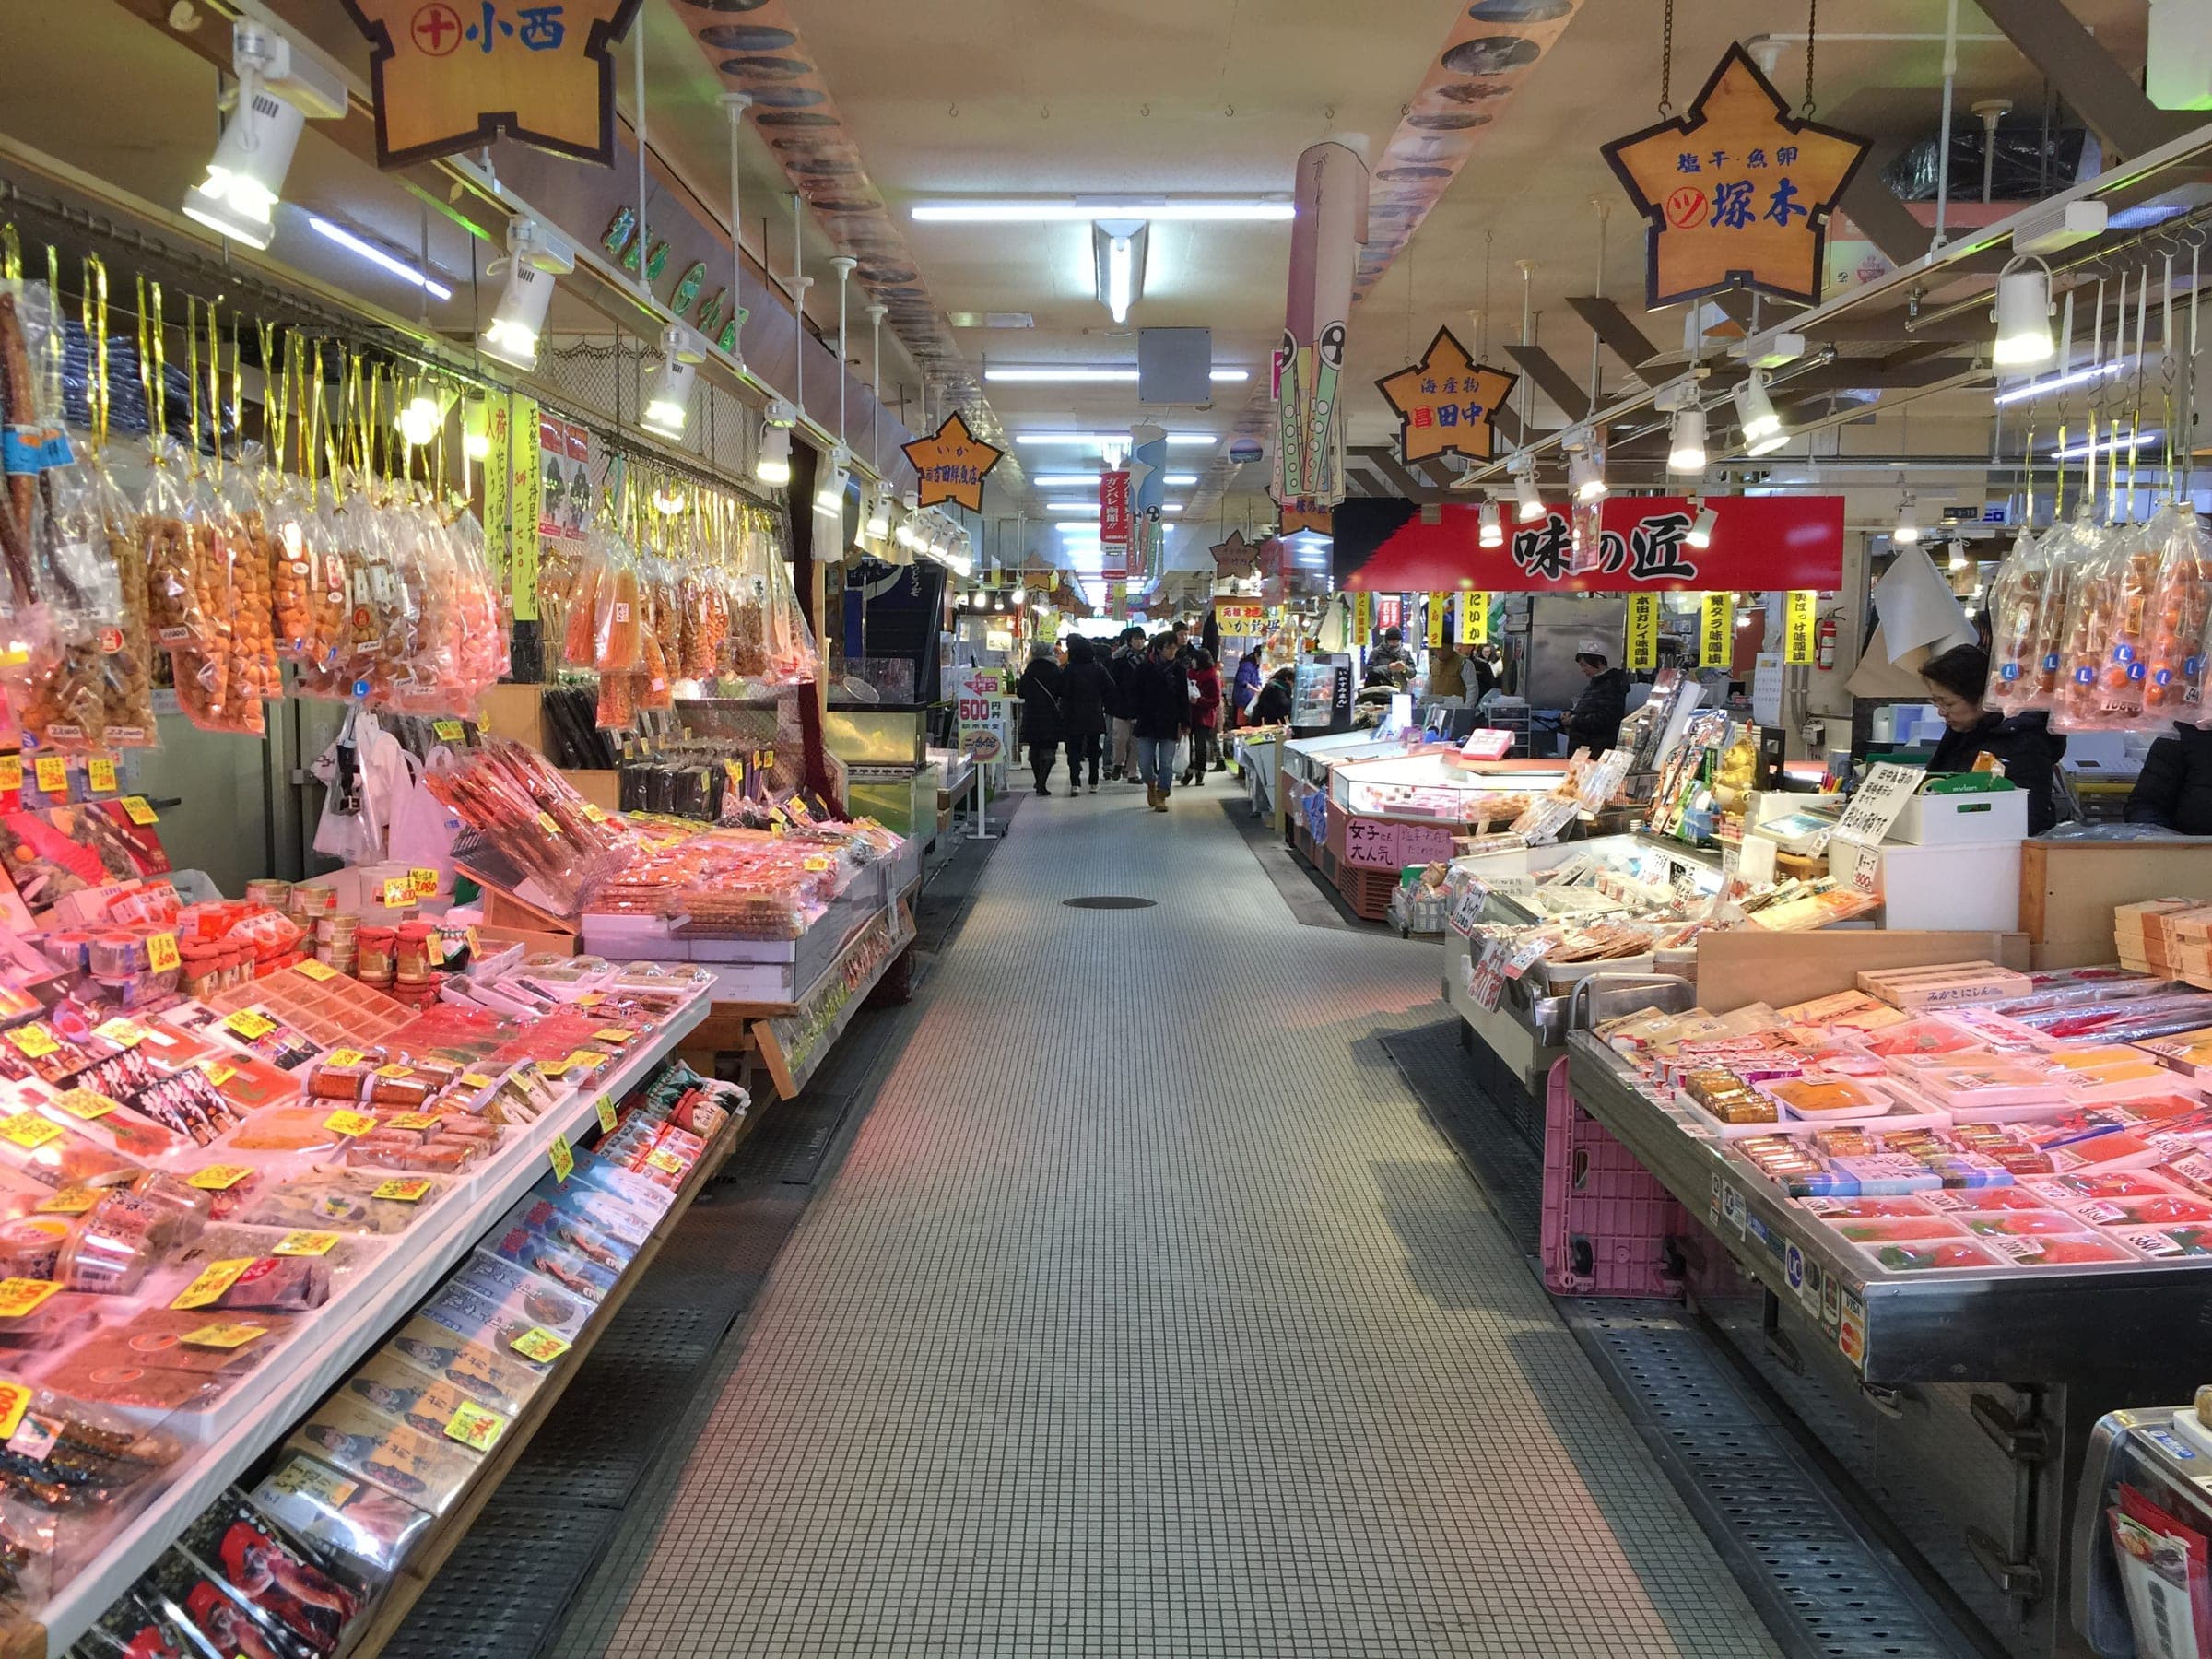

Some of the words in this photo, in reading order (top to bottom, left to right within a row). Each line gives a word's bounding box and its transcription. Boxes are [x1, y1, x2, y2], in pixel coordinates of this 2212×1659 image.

[465, 1, 566, 53] 小西
[1710, 177, 1807, 229] 塚本
[1421, 377, 1479, 394] 海産物
[1438, 402, 1483, 427] 田中
[959, 699, 989, 720] 500
[1351, 844, 1393, 865] 大人気
[1927, 987, 1990, 1001] みがきにしん
[1788, 1257, 1803, 1284] UC
[1846, 1296, 1860, 1316] VISA
